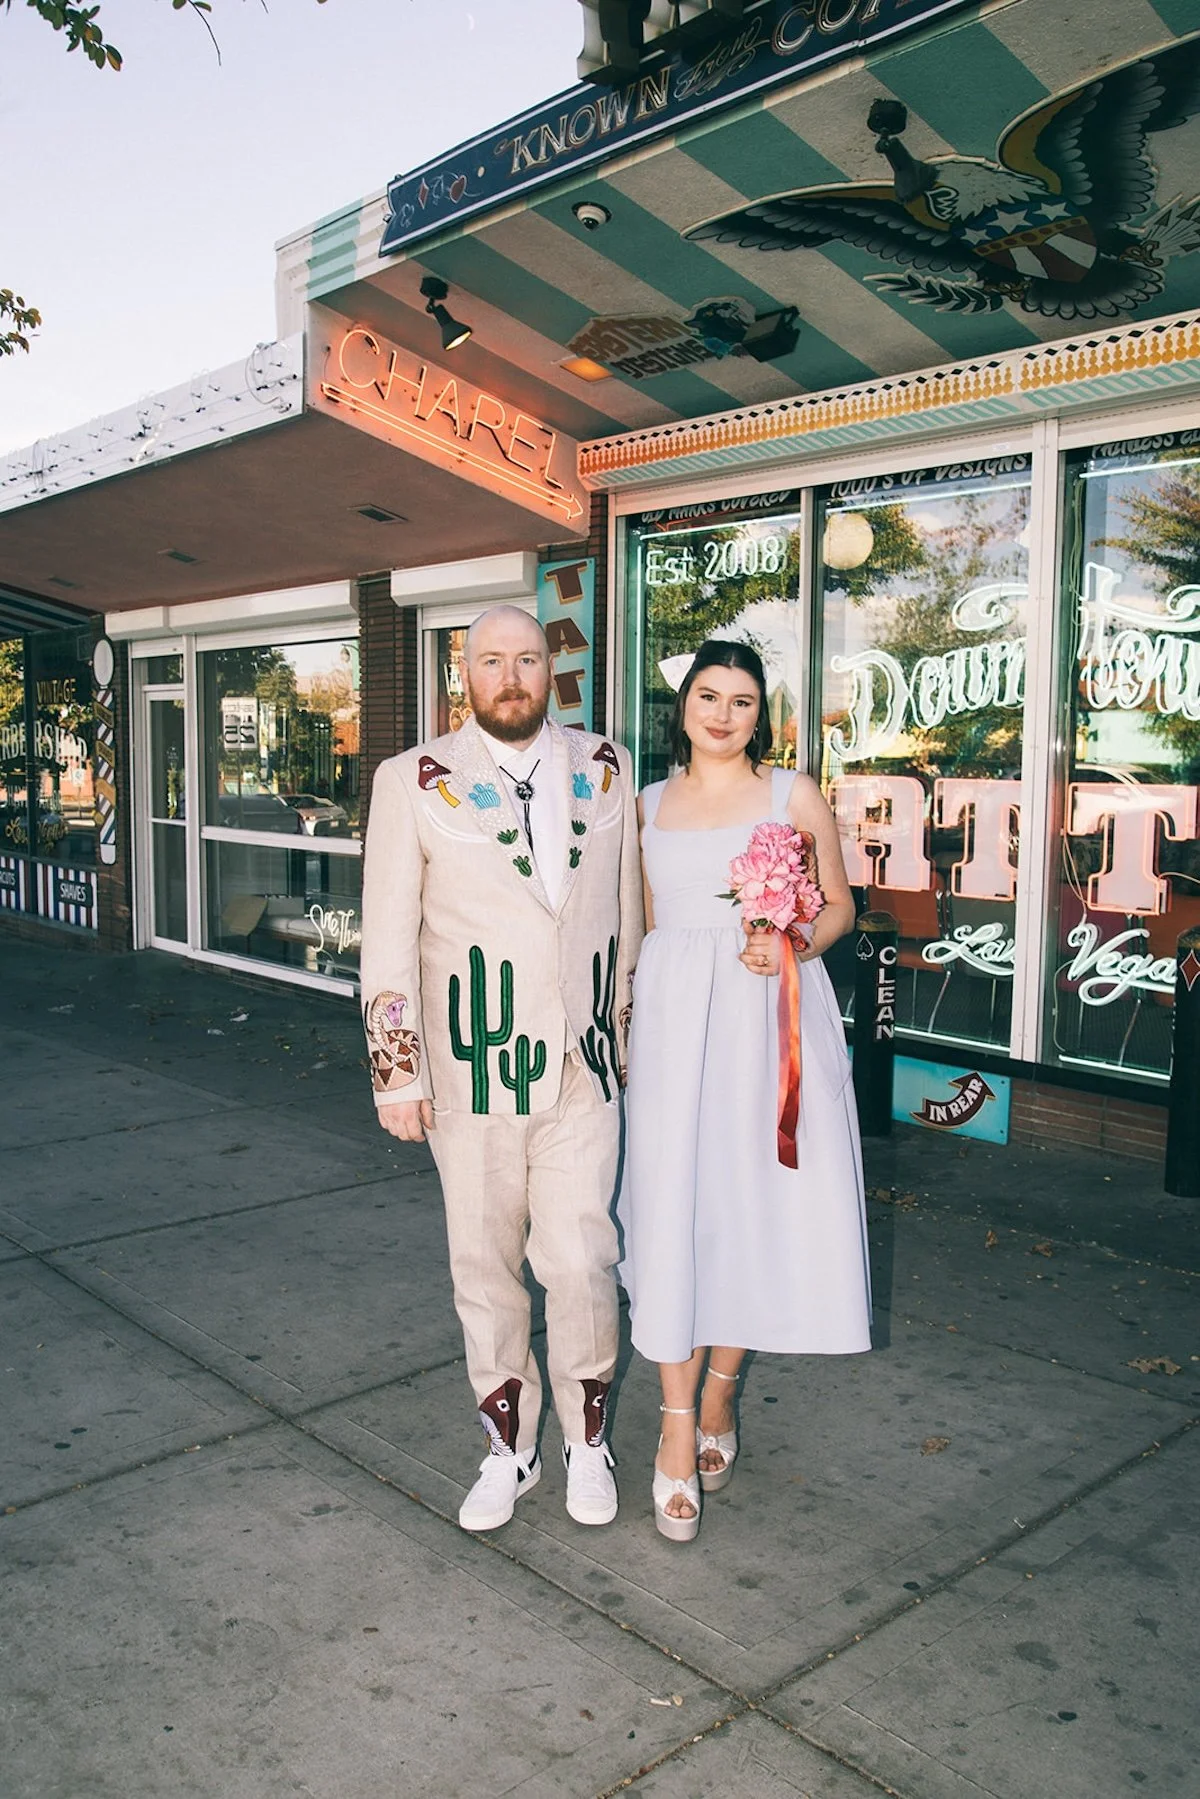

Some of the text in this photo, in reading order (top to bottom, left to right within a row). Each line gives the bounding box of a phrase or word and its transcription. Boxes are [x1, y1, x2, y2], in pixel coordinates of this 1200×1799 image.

[510, 64, 673, 174] KNOWN
[609, 338, 718, 380] DESIGNS
[338, 328, 565, 489] CHAPEL
[646, 535, 783, 586] Est 2008
[544, 560, 590, 731] TAT
[36, 678, 77, 704] VINTAGE
[0, 718, 88, 769] RBERSHOP
[60, 882, 86, 903] SHAVES
[1067, 923, 1177, 1006] Vega
[876, 946, 897, 1040] CLEAN
[929, 1078, 983, 1122] IN REAR
